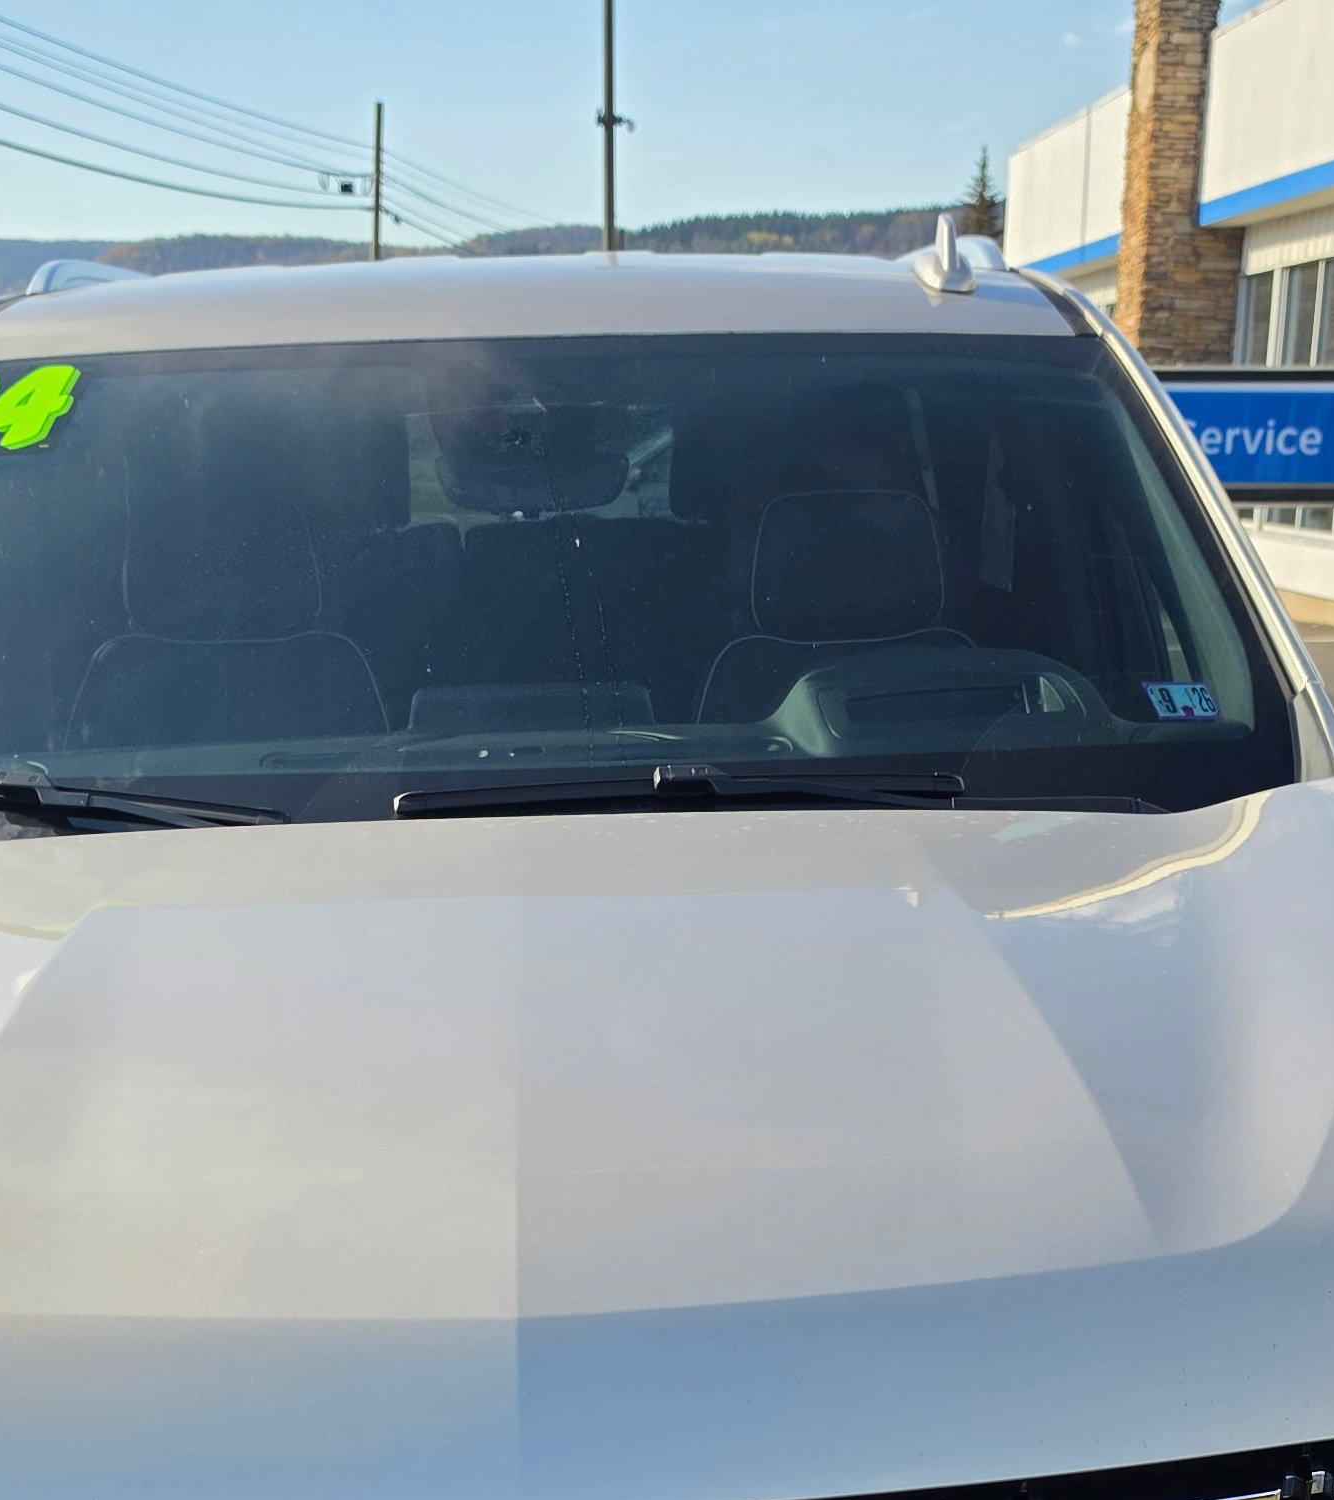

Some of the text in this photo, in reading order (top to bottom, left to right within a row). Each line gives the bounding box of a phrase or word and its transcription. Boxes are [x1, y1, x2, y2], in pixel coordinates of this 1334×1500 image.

[1184, 418, 1323, 456] ervice
[1158, 687, 1178, 714] 9
[1191, 687, 1217, 713] 26
